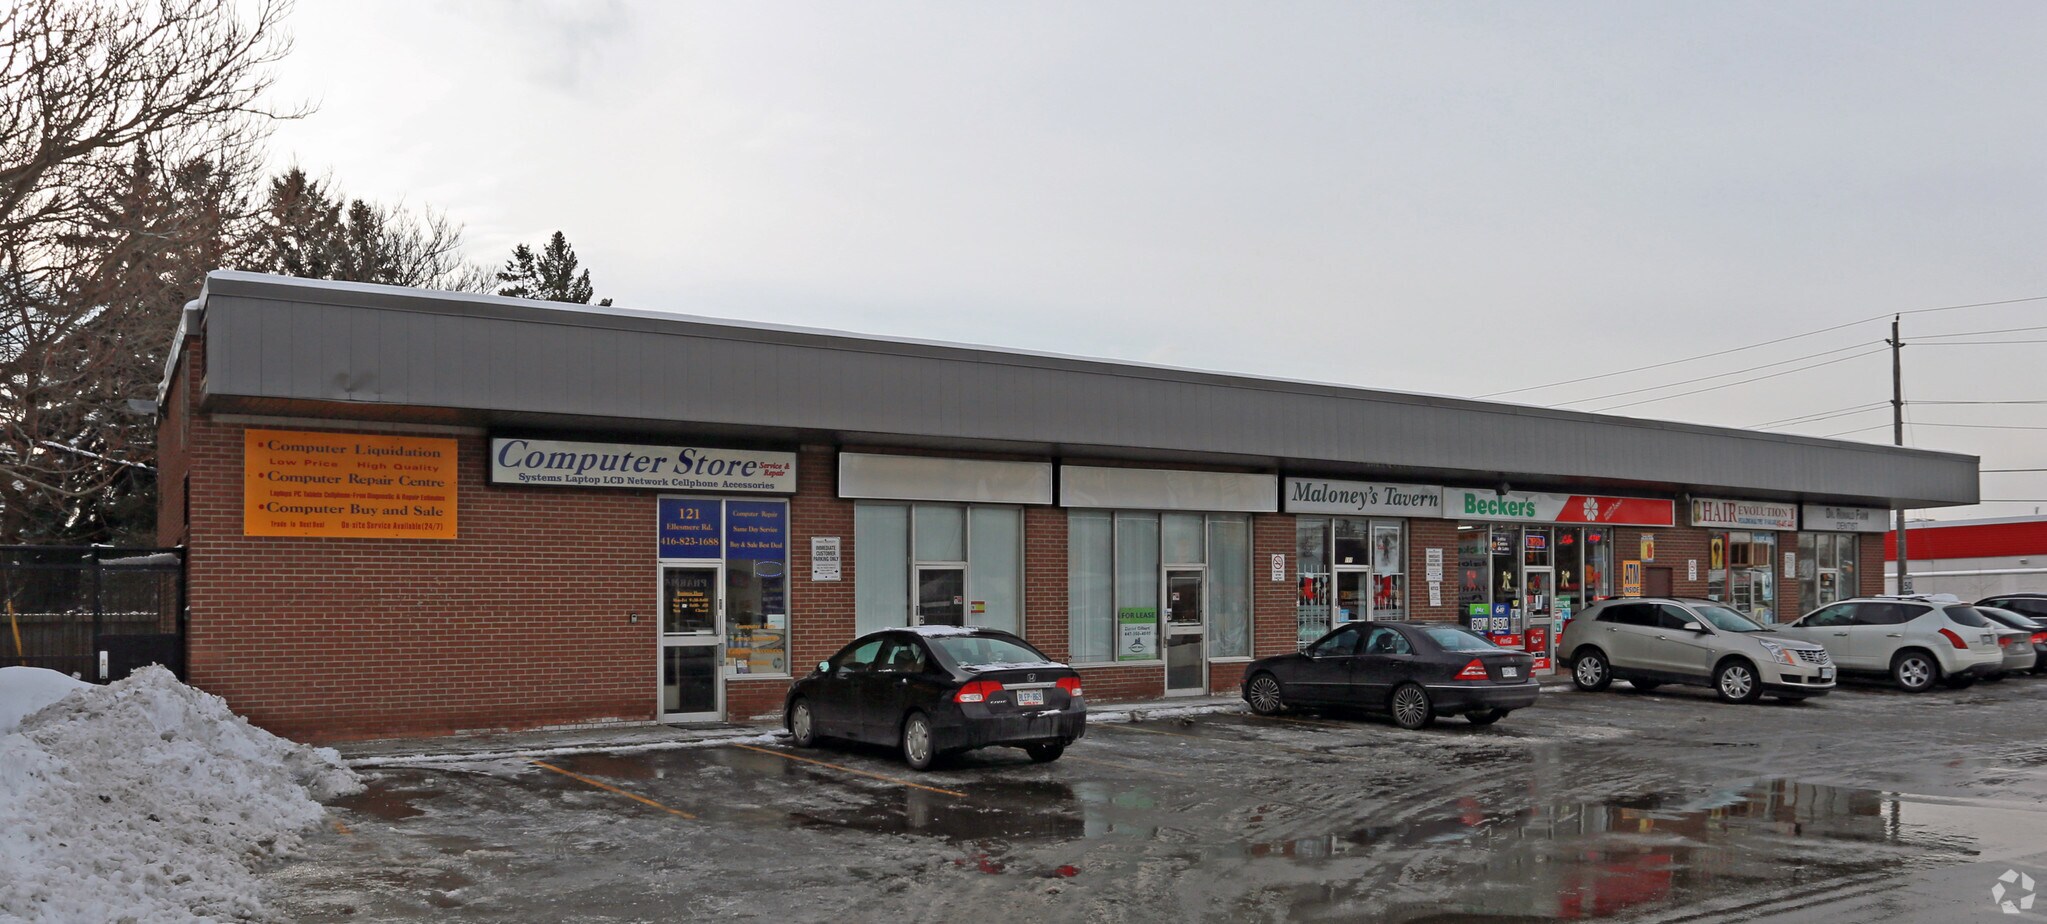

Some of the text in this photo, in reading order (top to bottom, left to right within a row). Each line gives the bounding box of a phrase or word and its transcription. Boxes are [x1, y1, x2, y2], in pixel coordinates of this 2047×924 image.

[268, 440, 441, 458] Computer Liquidation
[498, 440, 757, 477] Computer Store
[759, 462, 782, 470] Service
[357, 462, 386, 471] High
[394, 464, 439, 472] Quality
[764, 469, 784, 477] Repair
[268, 471, 445, 487] Computer Repair Centre
[519, 473, 774, 489] Systems Laptop LCD Network Cellphone Accessories
[1292, 482, 1438, 510] Maloney's Tavern
[267, 502, 443, 516] Computer Buy and Sale
[1464, 493, 1535, 517] Becker's
[1702, 501, 1737, 523] HAIR
[1738, 506, 1787, 517] EVOLUTION
[679, 508, 699, 519] 121
[367, 522, 391, 530] Service
[660, 537, 719, 546] 416-823-1688
[1625, 564, 1638, 584] ATM
